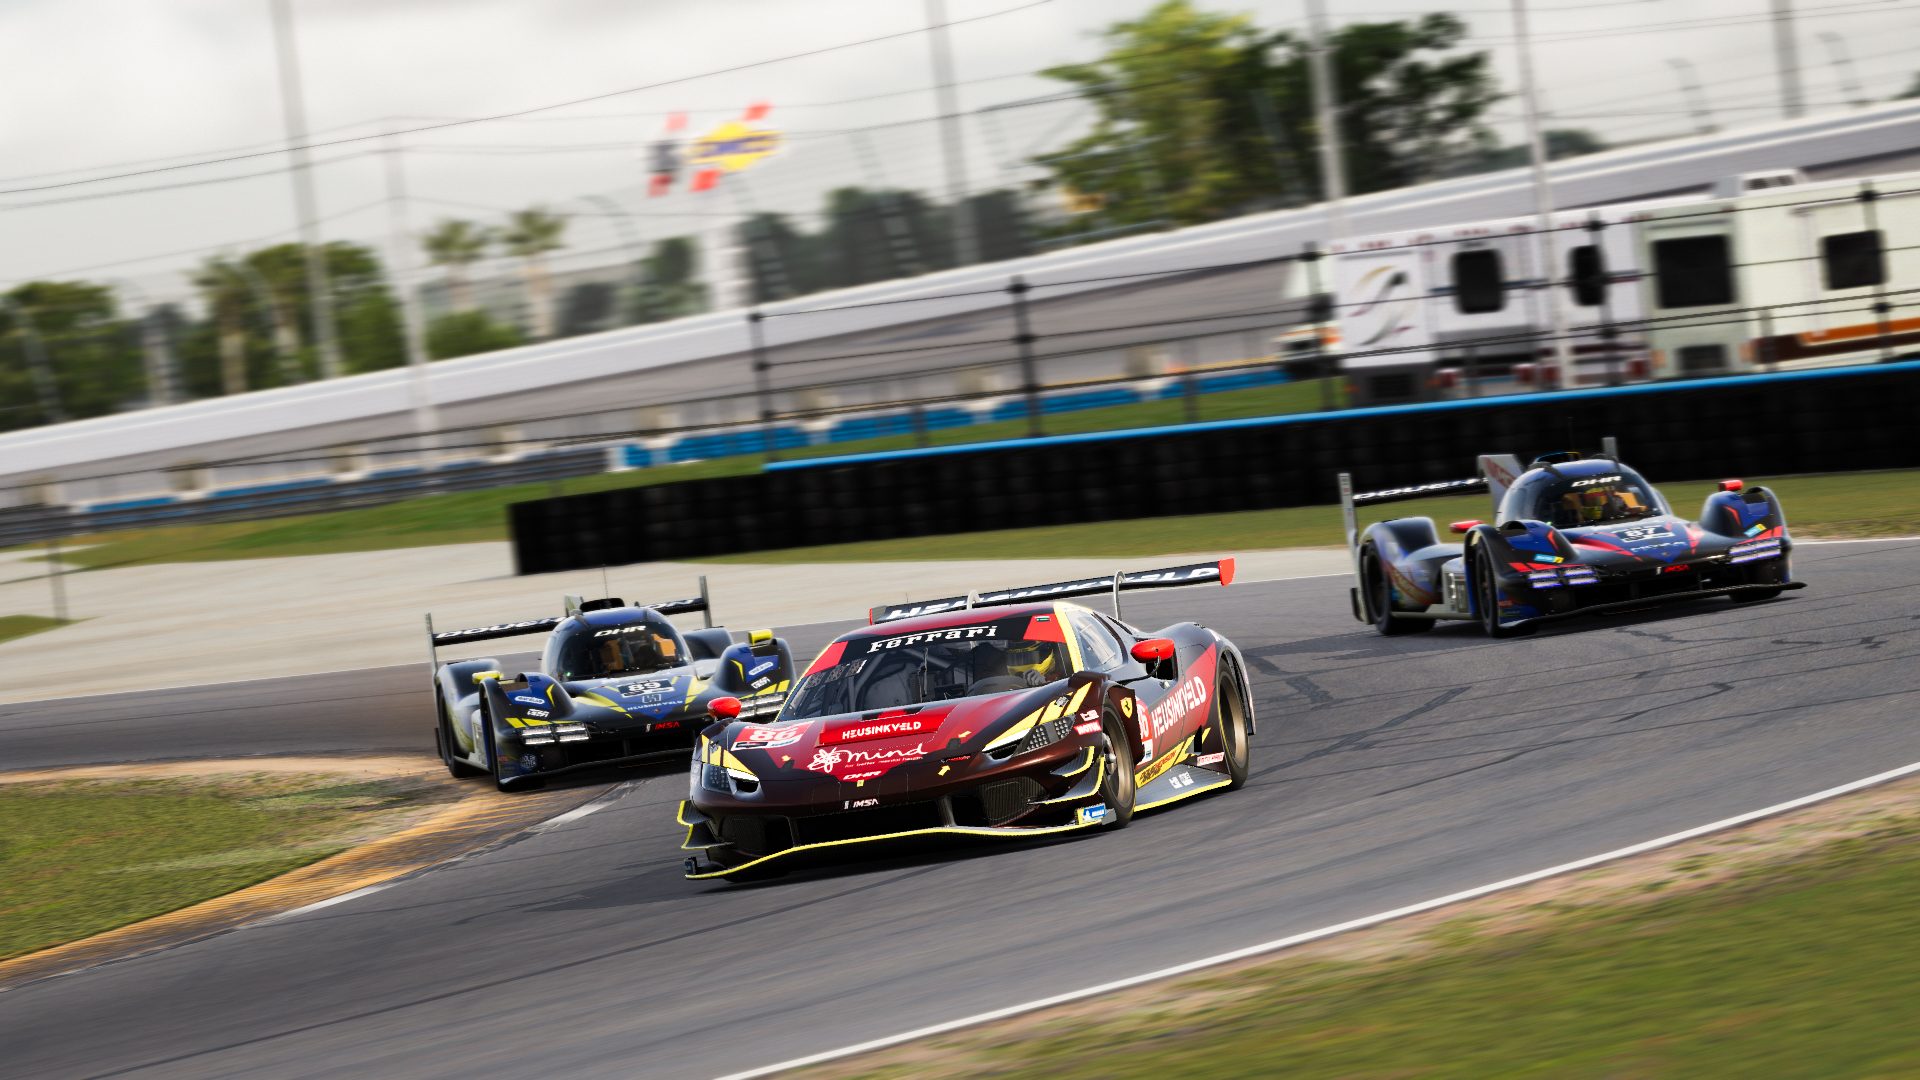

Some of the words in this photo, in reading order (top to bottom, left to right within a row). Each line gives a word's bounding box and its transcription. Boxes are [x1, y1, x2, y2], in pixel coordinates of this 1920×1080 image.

[594, 625, 646, 637] DHR
[867, 625, 998, 653] Ferrari
[627, 681, 662, 692] 89
[1151, 676, 1207, 739] HEUSINKVELD
[654, 721, 680, 731] IMSA
[842, 721, 922, 740] HEUSINKVELD
[749, 729, 797, 741] 86
[838, 743, 928, 763] mind
[853, 798, 879, 808] IMSA
